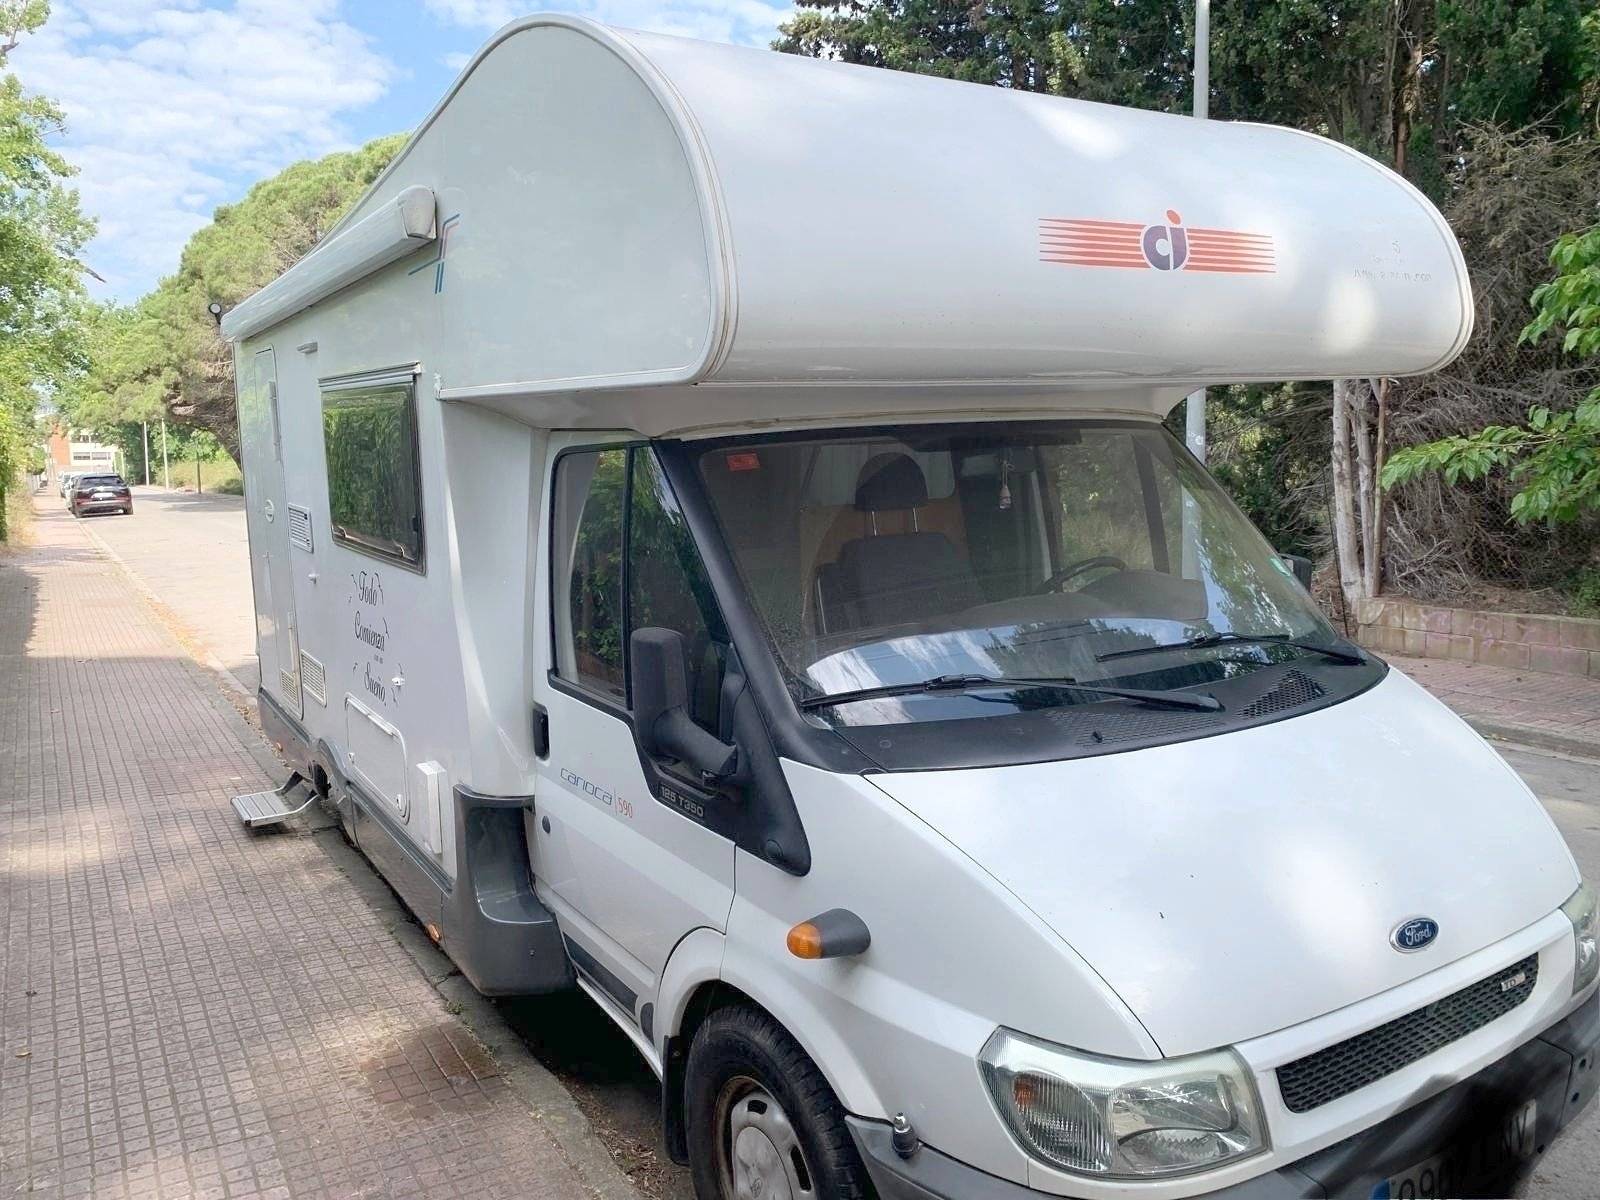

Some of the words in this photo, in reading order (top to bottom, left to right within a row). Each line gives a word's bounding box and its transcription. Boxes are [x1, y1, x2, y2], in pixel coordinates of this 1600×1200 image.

[358, 571, 377, 606] Todo
[355, 611, 385, 652] Comienza
[560, 768, 612, 805] carioca
[617, 798, 633, 818] 590
[660, 786, 677, 803] 125
[679, 795, 704, 817] T350
[1404, 921, 1432, 946] Ford
